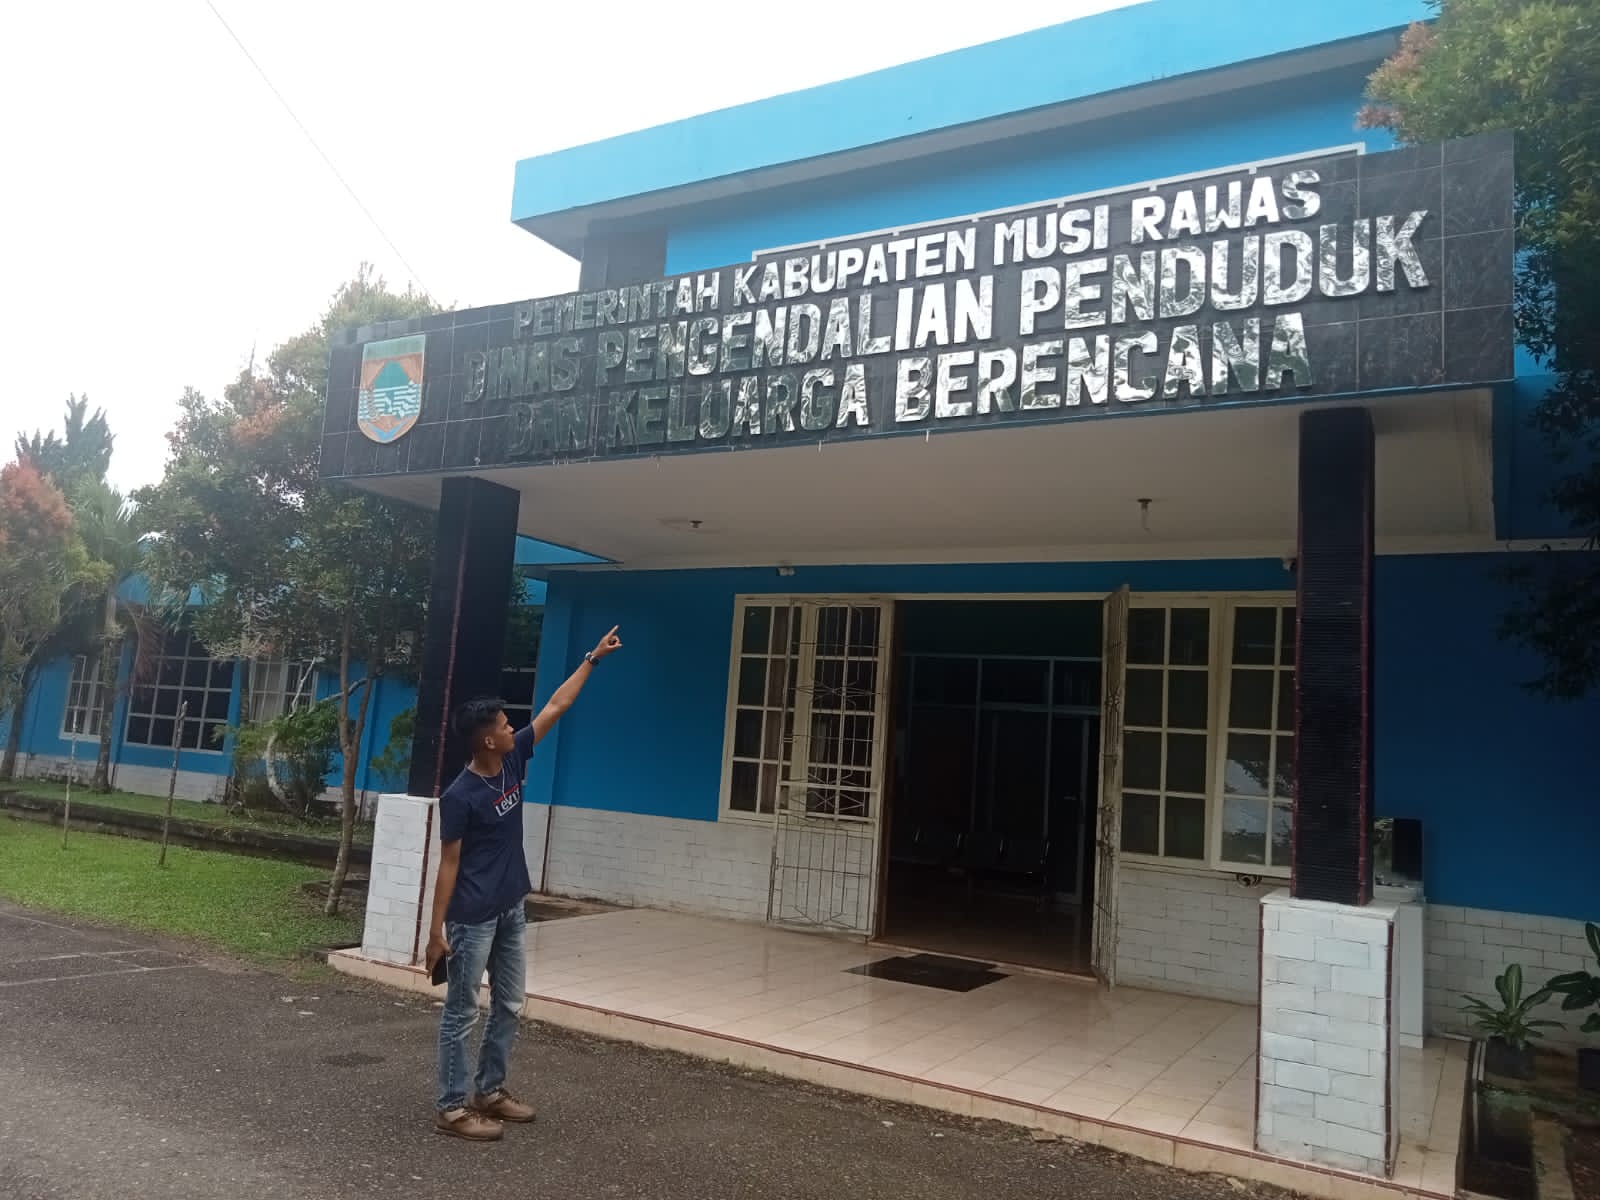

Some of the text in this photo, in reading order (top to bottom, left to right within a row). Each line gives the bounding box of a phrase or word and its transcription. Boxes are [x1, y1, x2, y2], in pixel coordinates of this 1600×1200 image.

[463, 209, 1430, 403] DINAS PENGENDALIAN PENDUDUK
[513, 169, 1321, 339] PEMERINTAH KABUPATEN MUSI RAWAS
[606, 363, 870, 448] KELUARGA
[895, 312, 1313, 423] BERENCANA
